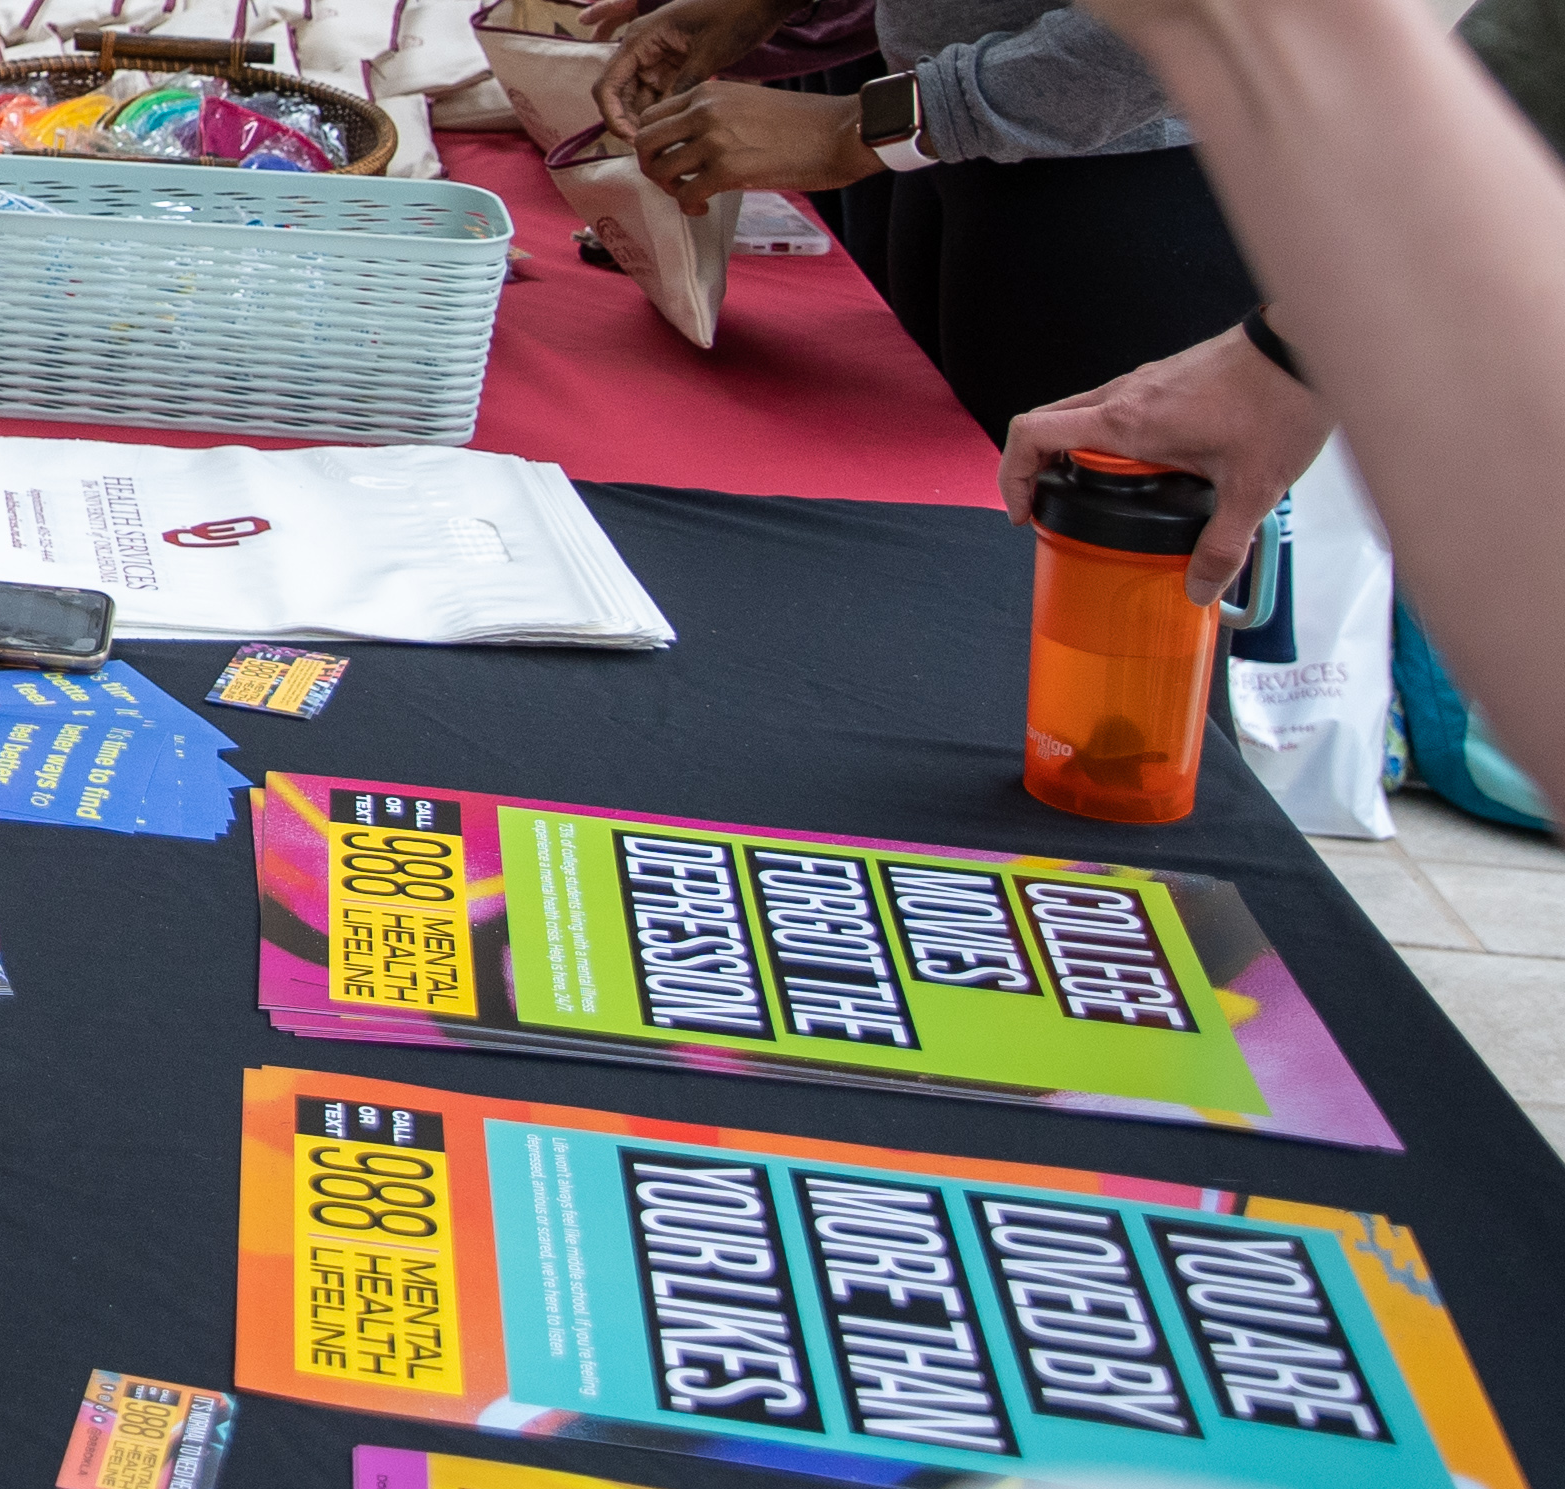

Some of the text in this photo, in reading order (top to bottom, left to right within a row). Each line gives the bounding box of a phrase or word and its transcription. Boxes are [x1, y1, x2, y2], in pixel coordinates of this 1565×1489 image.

[83, 490, 108, 531] UNIVERSITY
[103, 476, 159, 591] HEALTH SERVICES
[93, 540, 119, 583] OKLAHOMA
[10, 723, 40, 745] feel
[31, 723, 89, 808] better ways to
[1026, 723, 1074, 759] ontigo
[76, 740, 130, 821] time to find
[355, 794, 373, 824] TEXT
[385, 797, 402, 814] OR
[416, 799, 432, 829] CALL
[341, 831, 453, 902] 988
[532, 819, 560, 920] experience mental health
[342, 908, 376, 999] LIFELINE
[382, 911, 420, 1003] HEALTH
[421, 917, 460, 1006] MENTAL
[558, 822, 596, 1013] 73% college students living mental illness
[622, 834, 763, 1030] DEPRESSION
[754, 849, 909, 1048] FORGOT THE
[887, 865, 1030, 992] MOVIES
[1024, 882, 1185, 1032] COLLEGE
[323, 1102, 345, 1136] TEXT
[357, 1105, 379, 1126] OR
[392, 1109, 412, 1142] CALL
[308, 1146, 438, 1238] 988
[532, 1180, 562, 1312] anxious here
[551, 1137, 600, 1396] Life always middle feeling
[633, 1162, 807, 1414] YOUR LIKES.
[310, 1246, 346, 1370] LIFELINE
[355, 1252, 397, 1378] HEALTH
[400, 1257, 444, 1380] MENTAL
[805, 1177, 1008, 1451] MORE THAN
[981, 1198, 1188, 1436] LOVED BY
[1167, 1232, 1379, 1438] YOU ARE
[119, 1401, 171, 1440] 988
